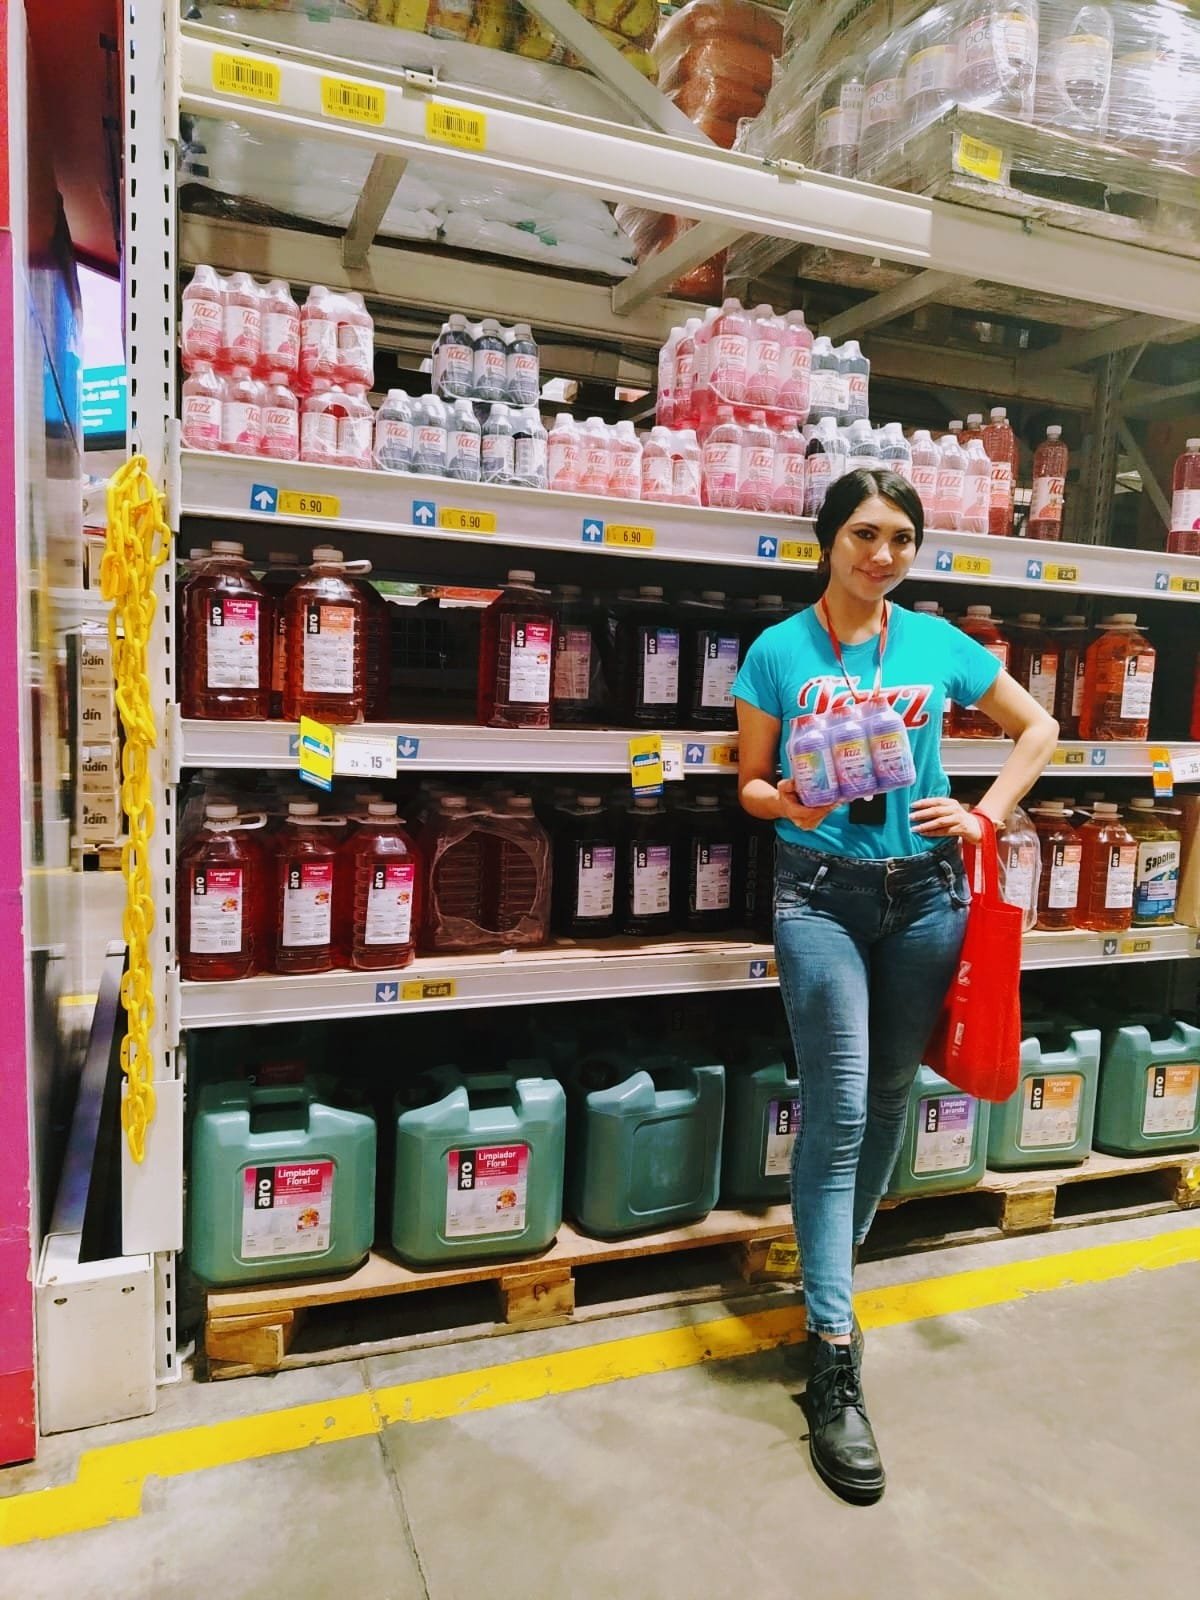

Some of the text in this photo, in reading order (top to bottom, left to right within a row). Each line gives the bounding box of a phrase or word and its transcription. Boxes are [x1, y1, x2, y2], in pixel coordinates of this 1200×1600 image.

[192, 302, 218, 318] Tazz
[186, 399, 211, 414] Tazz
[266, 410, 291, 425] Tazz
[384, 422, 409, 438] Tazz
[416, 427, 442, 444] Tazz
[456, 433, 477, 448] Tazz
[299, 498, 323, 514] 6.90
[459, 514, 481, 529] 6.90
[622, 529, 642, 543] 6.90
[796, 546, 814, 558] 9.90
[212, 606, 222, 626] aro
[309, 613, 319, 633] aro
[516, 629, 525, 647] aro
[648, 638, 656, 654] aro
[1033, 660, 1041, 674] aro
[1128, 660, 1137, 676] aro
[370, 755, 383, 769] 15
[662, 760, 672, 772] 15
[638, 852, 646, 867] aro
[1056, 852, 1064, 866] aro
[1112, 853, 1120, 867] aro
[195, 876, 205, 894] aro
[291, 871, 300, 889] aro
[375, 871, 384, 889] aro
[1154, 1076, 1165, 1096] aro
[1032, 1087, 1042, 1108] aro
[779, 1110, 789, 1133] aro
[927, 1108, 937, 1131] aro
[478, 1150, 517, 1161] Limpiador
[486, 1159, 508, 1168] Floral
[278, 1167, 320, 1178] Limpiador
[461, 1161, 473, 1188] aro
[286, 1177, 311, 1186] Floral
[258, 1178, 272, 1207] aro
